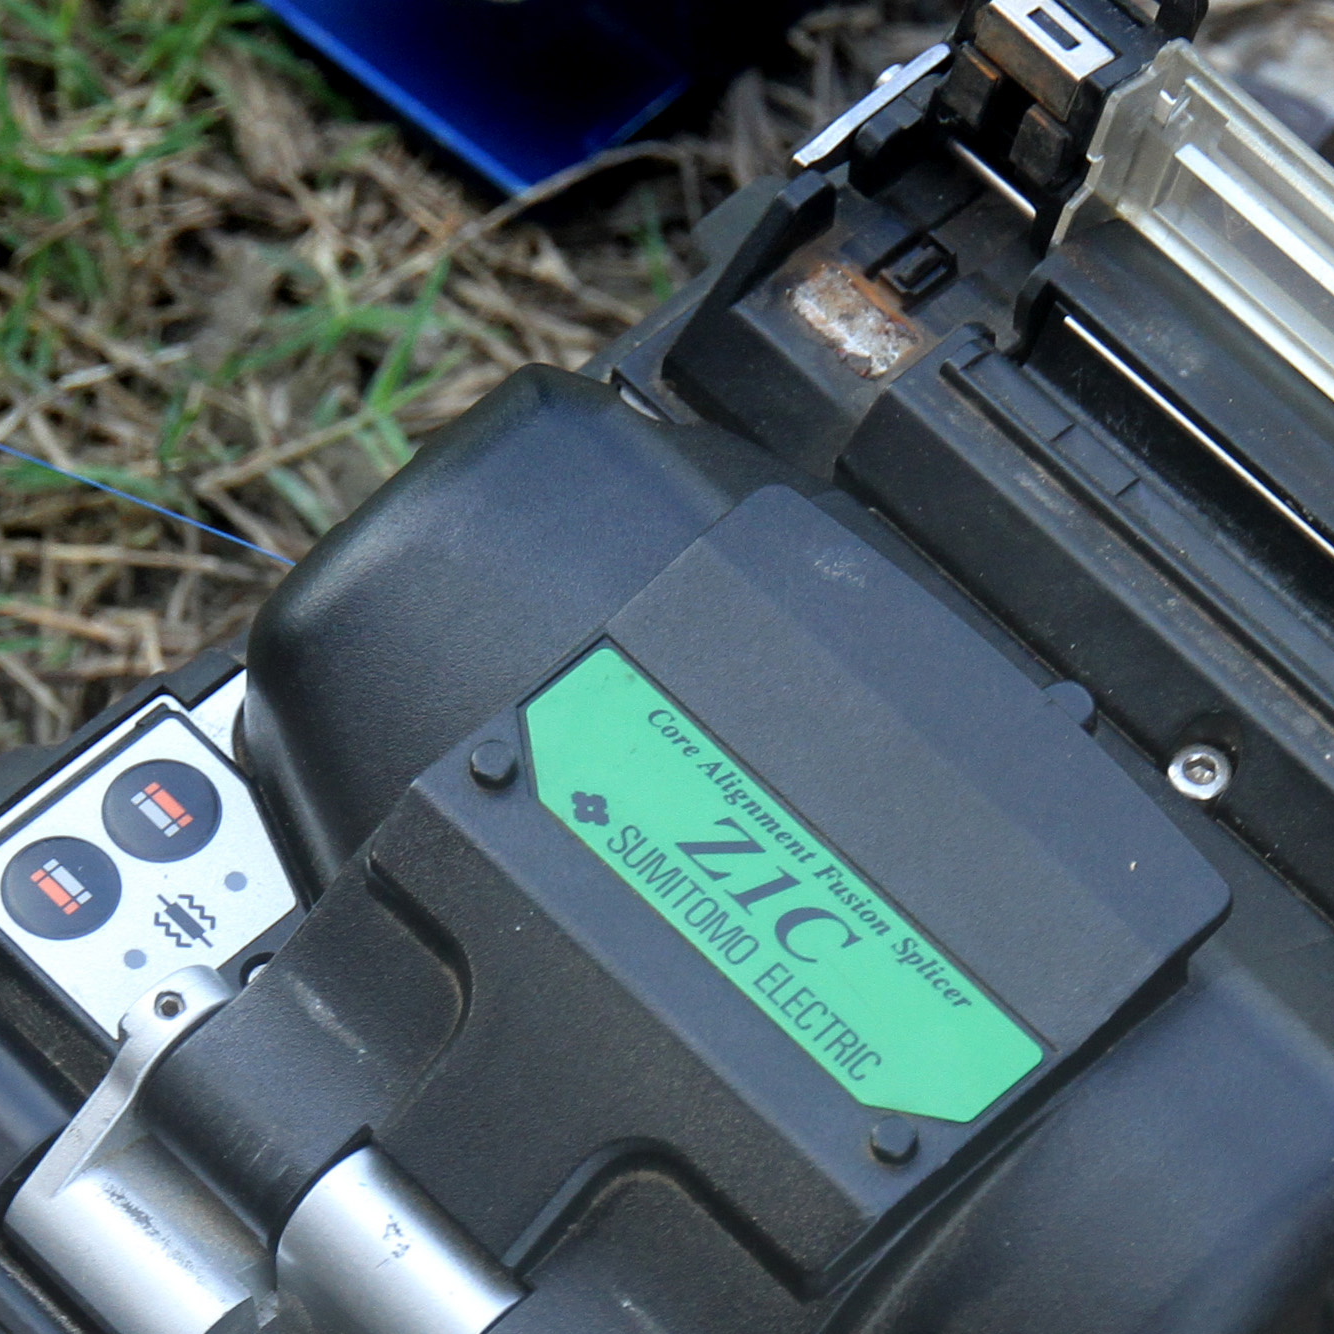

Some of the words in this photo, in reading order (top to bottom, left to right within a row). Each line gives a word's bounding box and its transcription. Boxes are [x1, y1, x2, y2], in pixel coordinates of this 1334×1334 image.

[607, 824, 761, 966] SUMITOMO
[753, 962, 882, 1084] ELECTRIC
[648, 709, 699, 757] Core
[698, 757, 817, 865] Alignment
[815, 862, 891, 938] Fusion
[892, 938, 972, 1008] Splicer
[675, 816, 861, 964] ZIC
